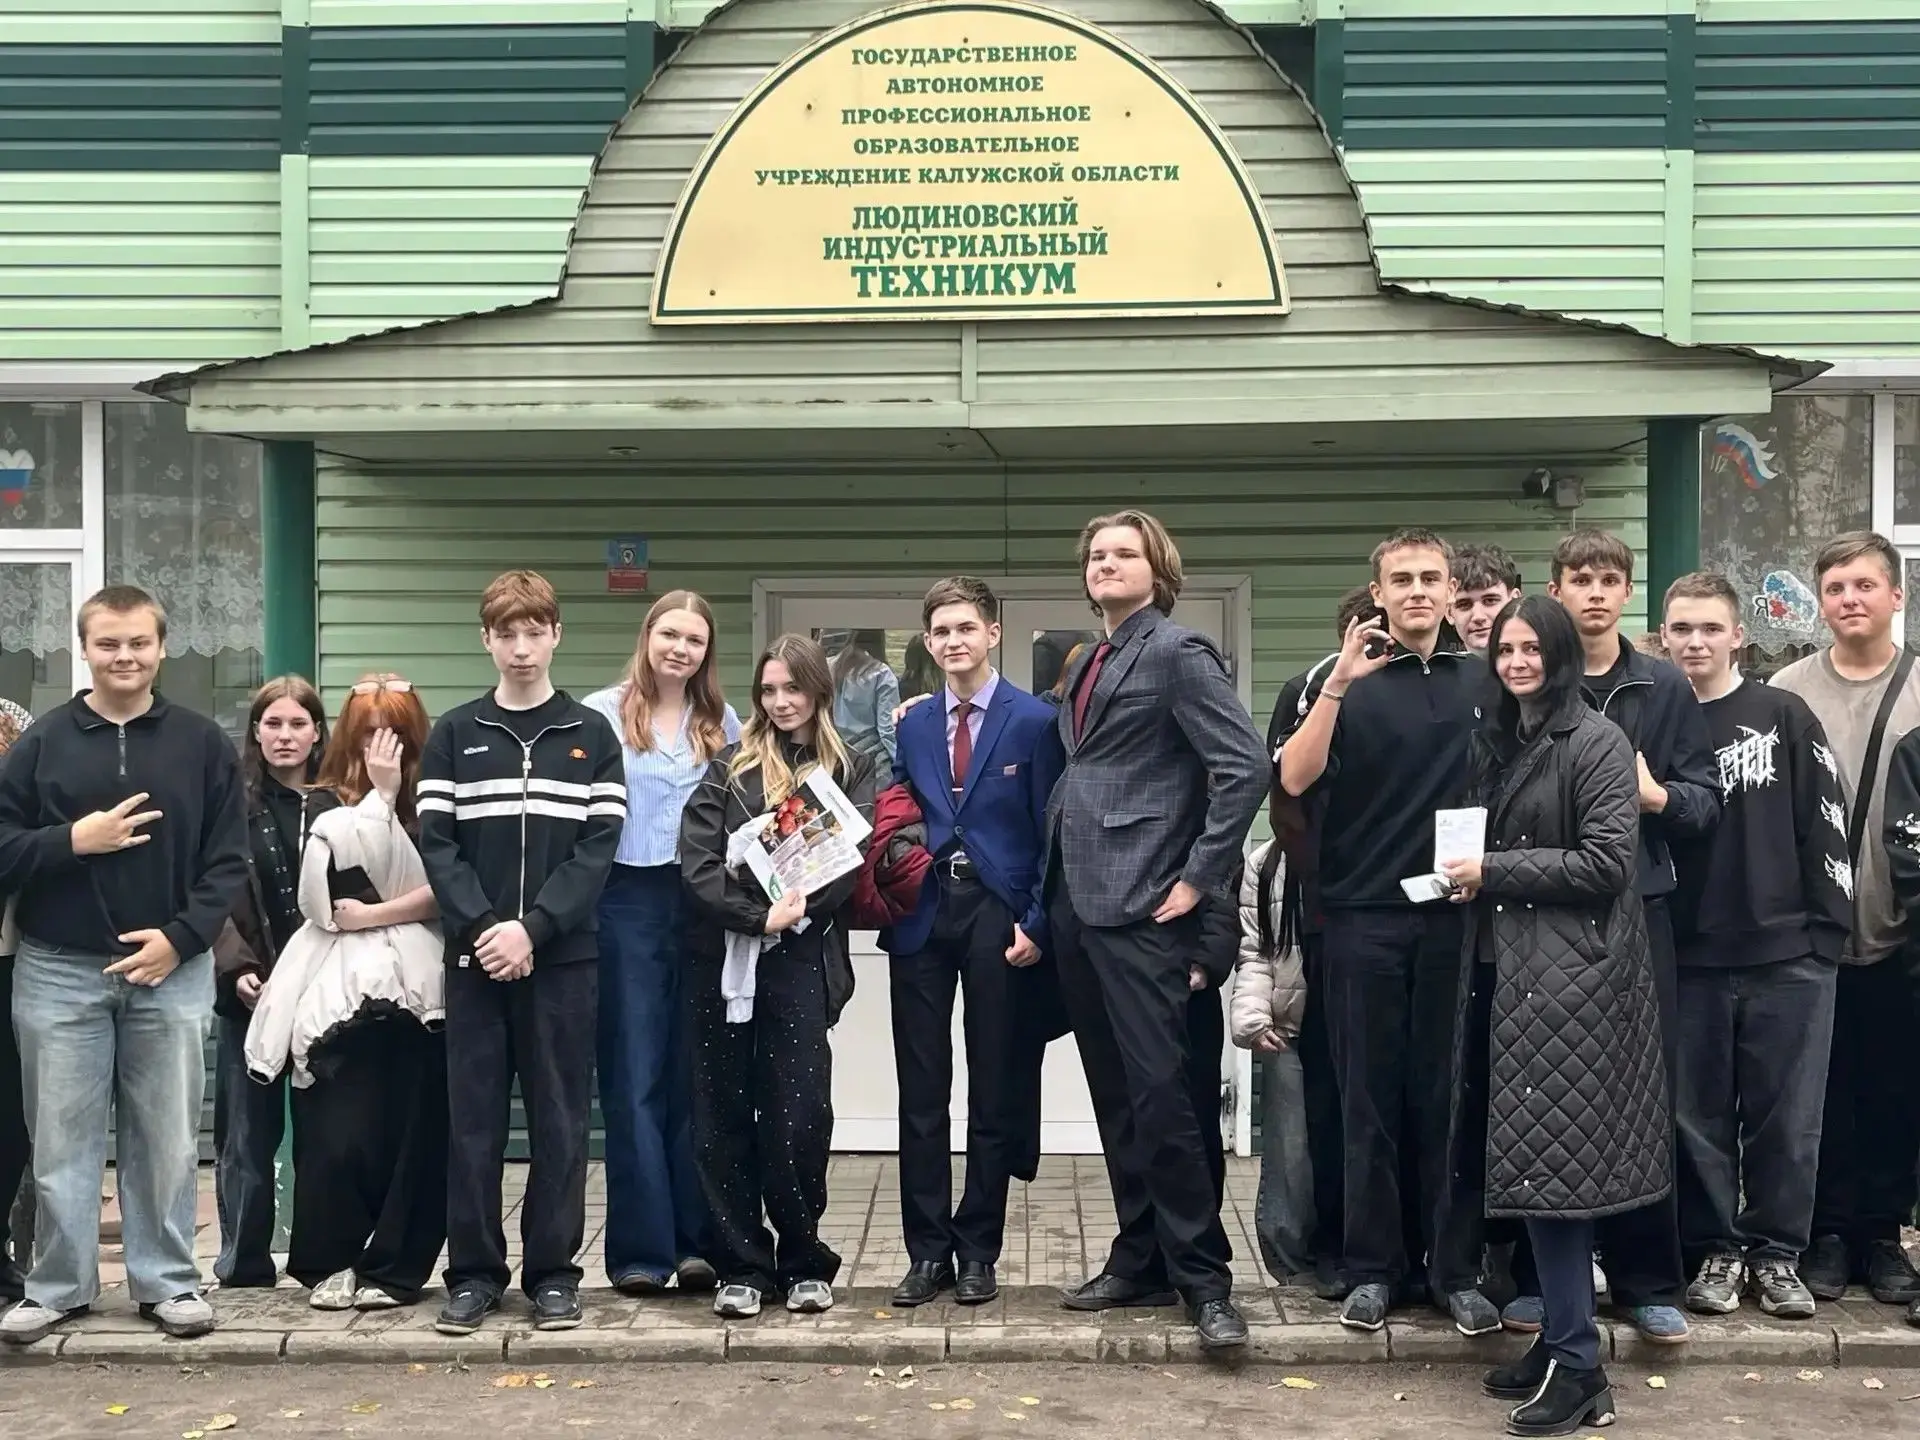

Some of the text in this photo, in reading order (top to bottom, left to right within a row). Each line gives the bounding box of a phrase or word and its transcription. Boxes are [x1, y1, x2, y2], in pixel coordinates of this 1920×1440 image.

[851, 45, 1077, 66] ГОСУДАРСТВЕННОЕ
[885, 75, 1044, 95] АВТОНОМНОЕ
[841, 105, 1091, 125] ПРОФЕССИОНАЛЬНОЕ
[853, 135, 1079, 155] ОБРАЗОВАТЕЛЬНОЕ
[754, 163, 1180, 188] УЧРЕЖДЕНИЕ КАЛУЖСКОЙ ОБЛАСТИ
[851, 197, 1079, 235] ЛЮДИНОВСКИЙ
[822, 226, 1109, 265] ИНДУСТРИАЛЬНЫЙ
[850, 262, 1077, 298] ТЕХНИКУМ
[1755, 597, 1769, 617] Я
